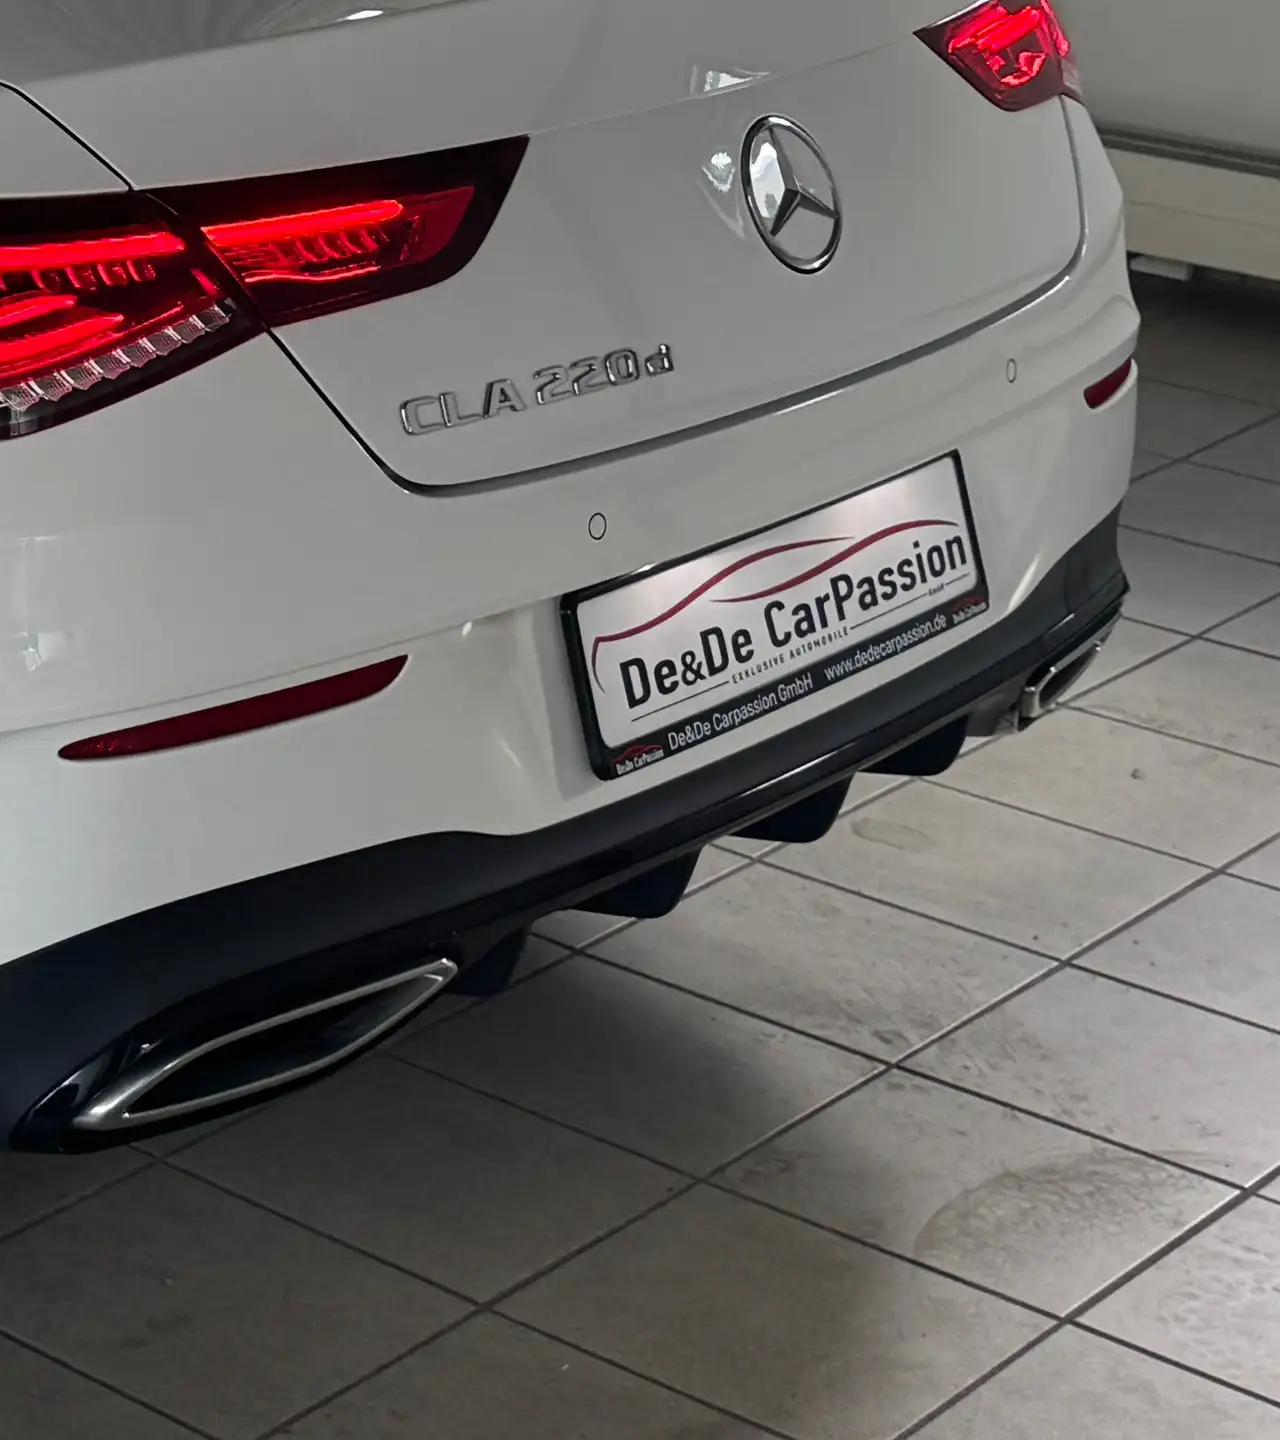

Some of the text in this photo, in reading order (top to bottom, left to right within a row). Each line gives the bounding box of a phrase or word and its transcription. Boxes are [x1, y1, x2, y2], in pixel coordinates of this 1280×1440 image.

[399, 378, 527, 436] CLA
[619, 535, 967, 709] De&De CarPassion
[732, 626, 849, 684] EXKLUSIVE AUTOMOBILE
[824, 611, 947, 681] www.dedecarpassion.de
[668, 672, 814, 750] De&De Carpassion GmbH
